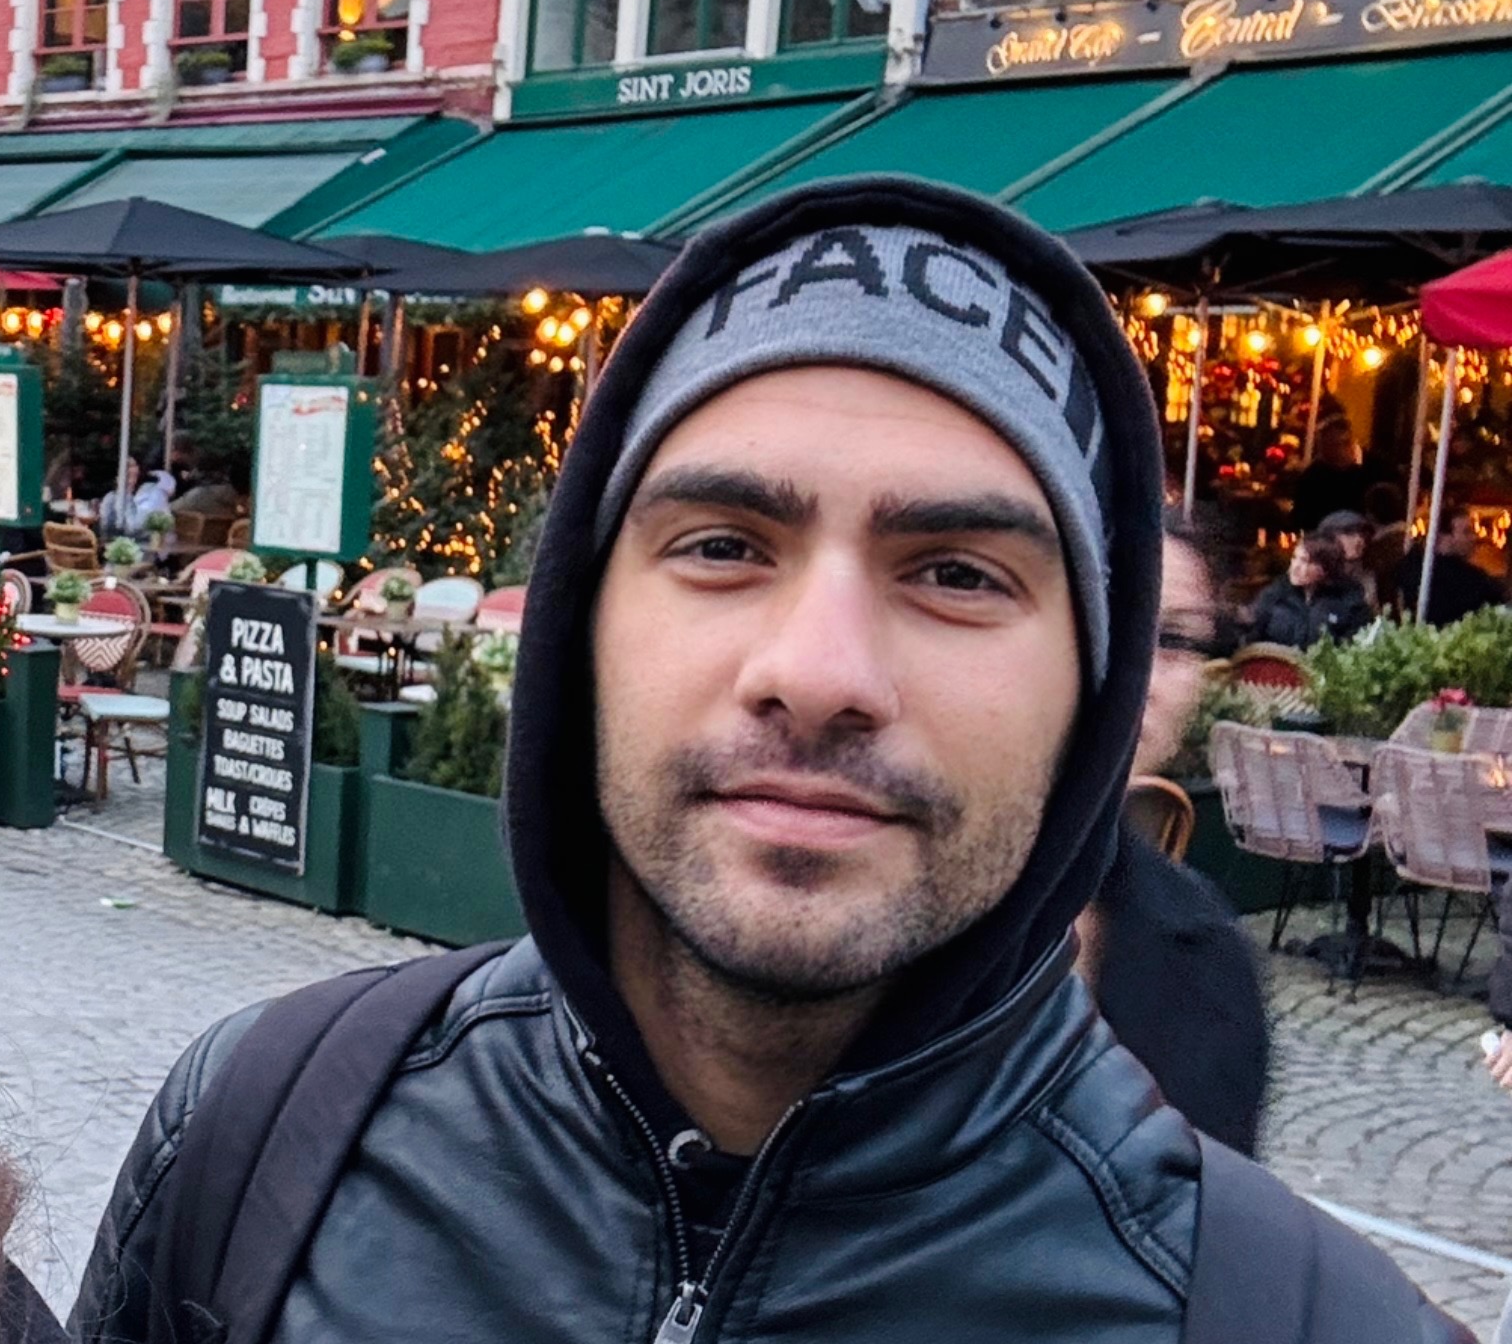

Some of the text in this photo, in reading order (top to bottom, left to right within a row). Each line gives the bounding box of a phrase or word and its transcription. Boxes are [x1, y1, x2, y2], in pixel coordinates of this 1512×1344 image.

[617, 66, 752, 104] SINT JORIS
[704, 228, 1065, 404] FACE
[231, 617, 285, 655] PIZZA
[219, 653, 294, 694] & PASTA
[216, 698, 294, 732] SOUP SALADS
[222, 728, 285, 761] BAGUETTES
[205, 786, 236, 814] MILK
